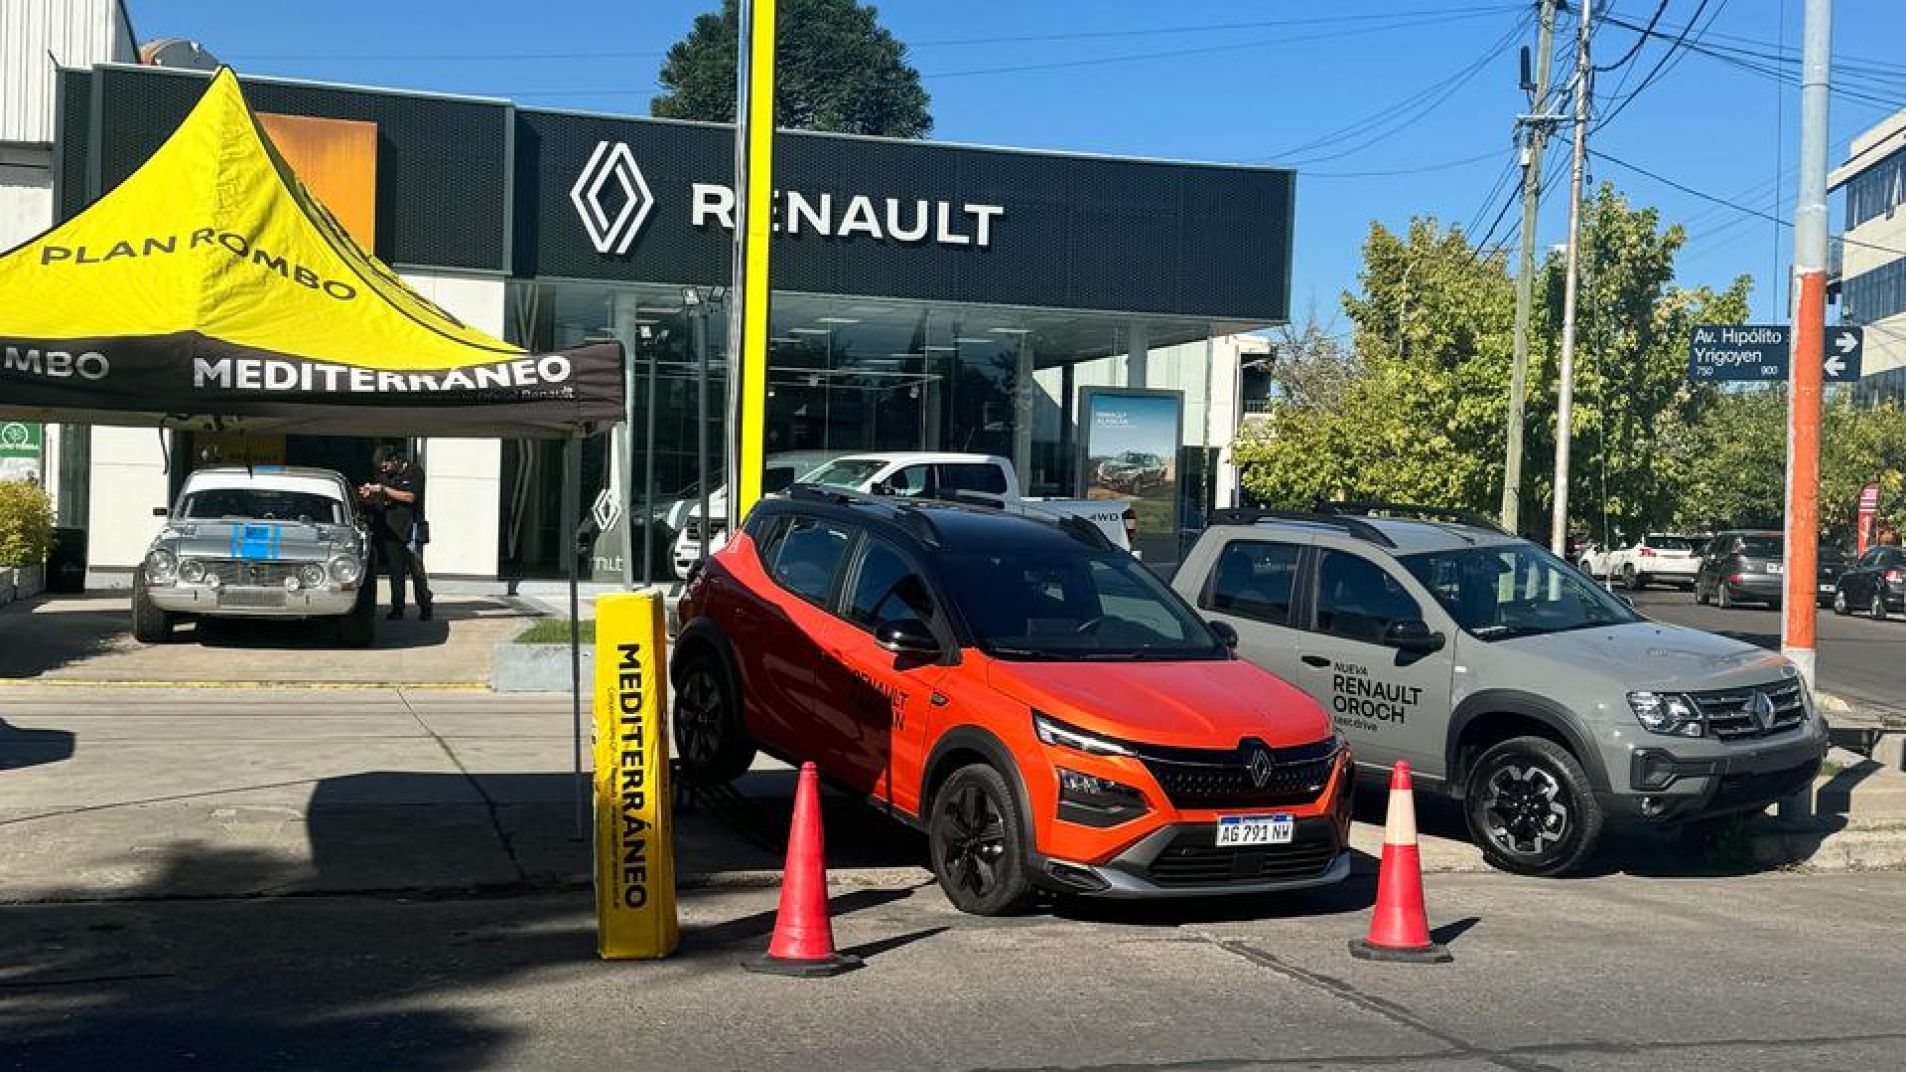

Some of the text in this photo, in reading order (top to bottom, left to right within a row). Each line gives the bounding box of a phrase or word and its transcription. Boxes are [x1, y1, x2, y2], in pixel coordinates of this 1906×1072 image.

[692, 182, 1004, 246] RNAULT
[41, 228, 357, 300] PLAN ROMBO
[1694, 327, 1782, 347] Av. Hipólito
[1695, 347, 1762, 367] Yrigoyen
[1333, 674, 1423, 706] RENAULT
[1333, 695, 1405, 724] OROCH
[617, 644, 651, 909] MEDITERRÁNEO
[1222, 825, 1240, 842] AG
[1243, 824, 1268, 842] 791
